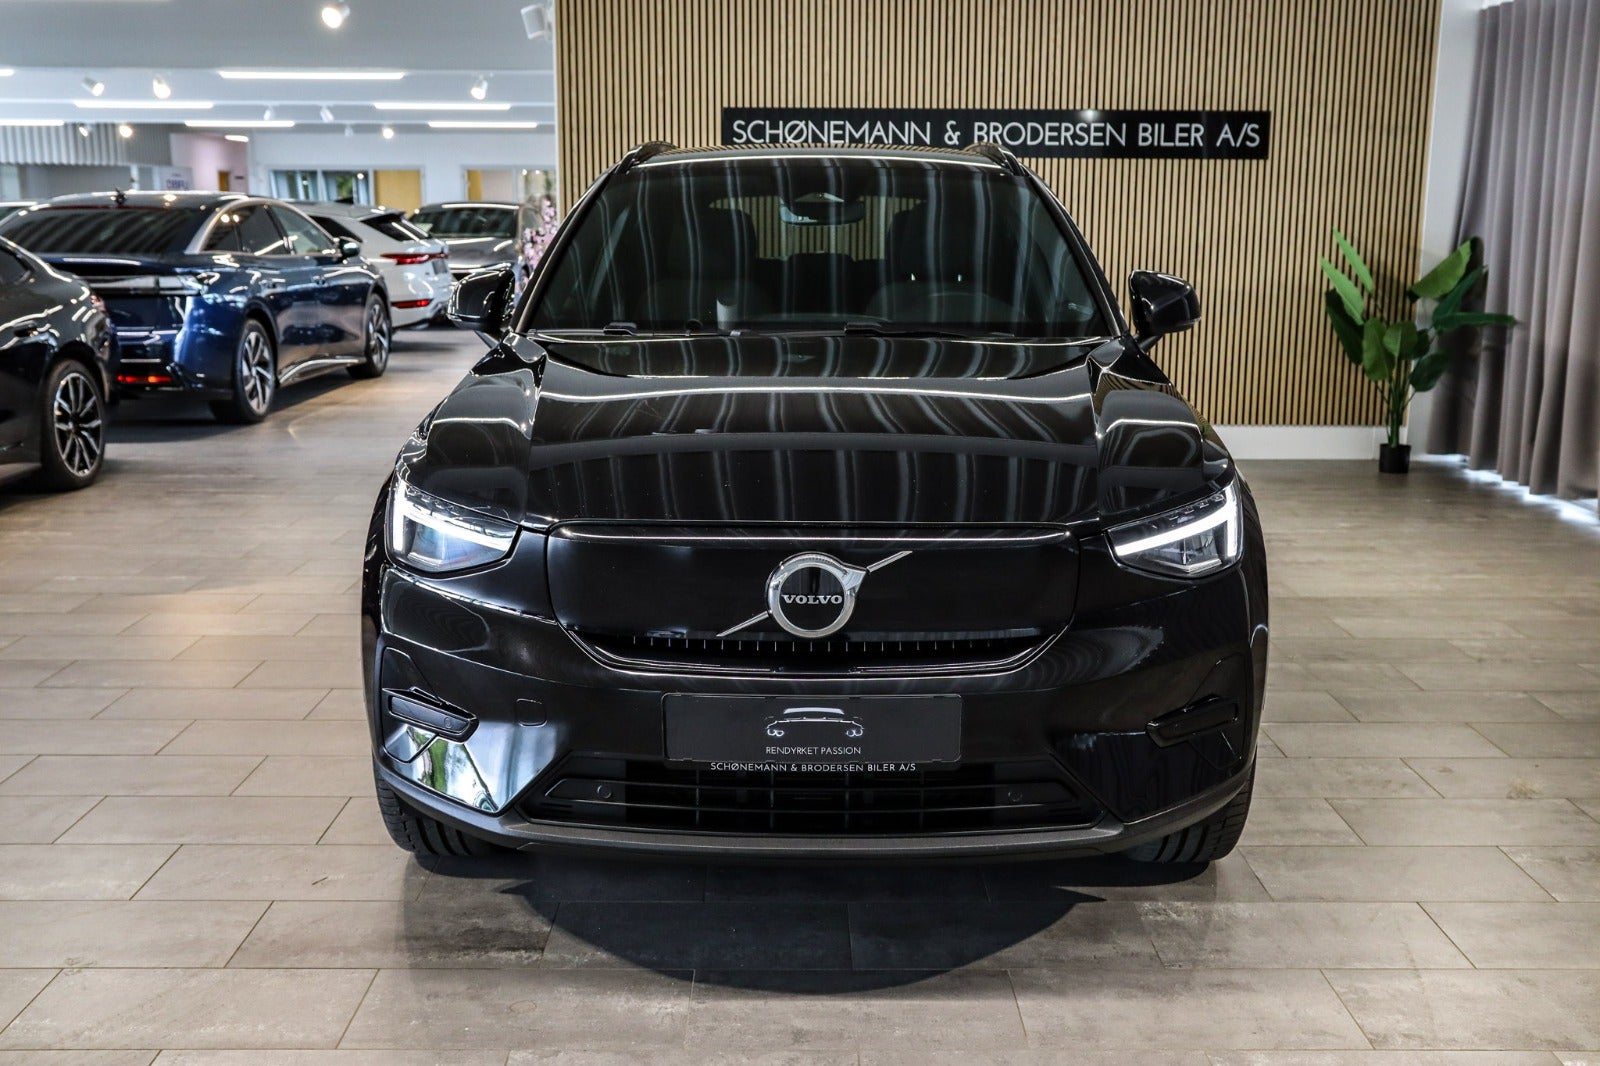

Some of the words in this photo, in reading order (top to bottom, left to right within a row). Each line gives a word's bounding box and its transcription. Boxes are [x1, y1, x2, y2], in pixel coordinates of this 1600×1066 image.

[732, 120, 931, 145] SCHØNEMANN
[944, 120, 961, 146] &
[973, 121, 1127, 147] BRODERSEN
[1137, 122, 1205, 147] BILER
[1215, 122, 1261, 147] A/S
[781, 594, 843, 605] VOLVO
[765, 746, 819, 755] RENDYRKET
[820, 746, 862, 755] PASSION
[710, 762, 787, 772] SCHØNEMANN
[790, 763, 798, 772] &
[801, 763, 864, 772] BRODERSEN
[867, 763, 896, 772] BILER
[899, 762, 917, 772] A/S
